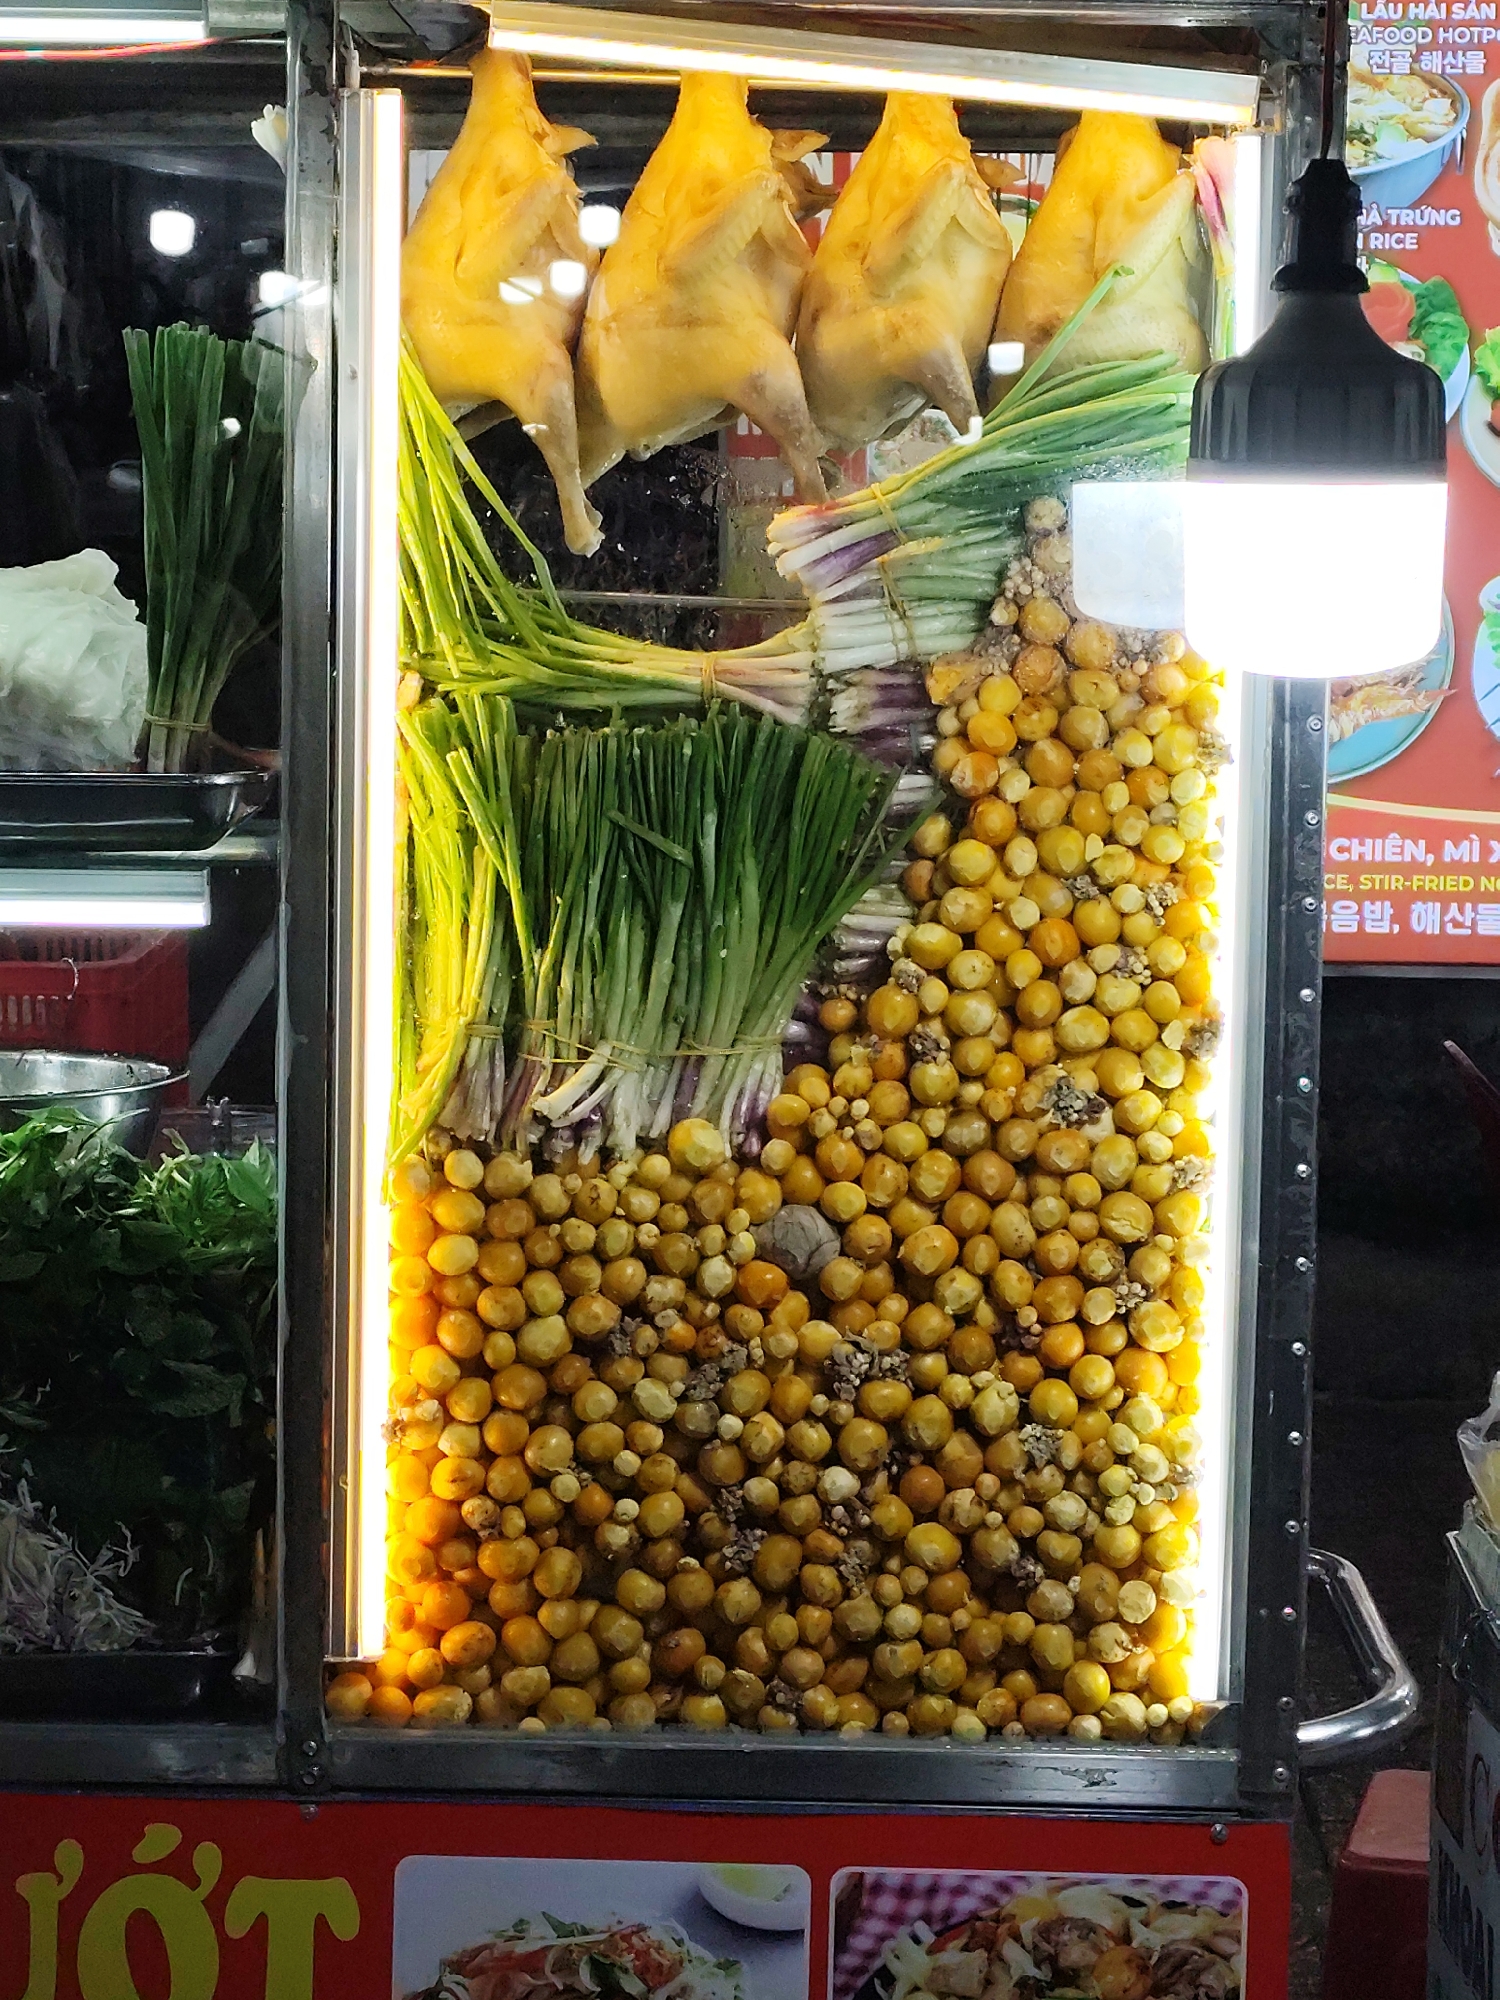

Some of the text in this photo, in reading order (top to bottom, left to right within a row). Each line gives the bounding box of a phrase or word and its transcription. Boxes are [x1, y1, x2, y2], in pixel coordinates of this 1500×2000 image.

[1350, 27, 1433, 44] EAFOOD
[1369, 50, 1487, 75] 전골 해산물
[1387, 204, 1461, 226] TRỨNG
[1370, 232, 1419, 250] RICE
[1329, 832, 1435, 867] CHIÊN,
[1444, 833, 1480, 864] MÌ
[1324, 873, 1354, 892] CE,
[1359, 874, 1475, 892] STIR-FRIED
[1321, 900, 1400, 935] 음밥,
